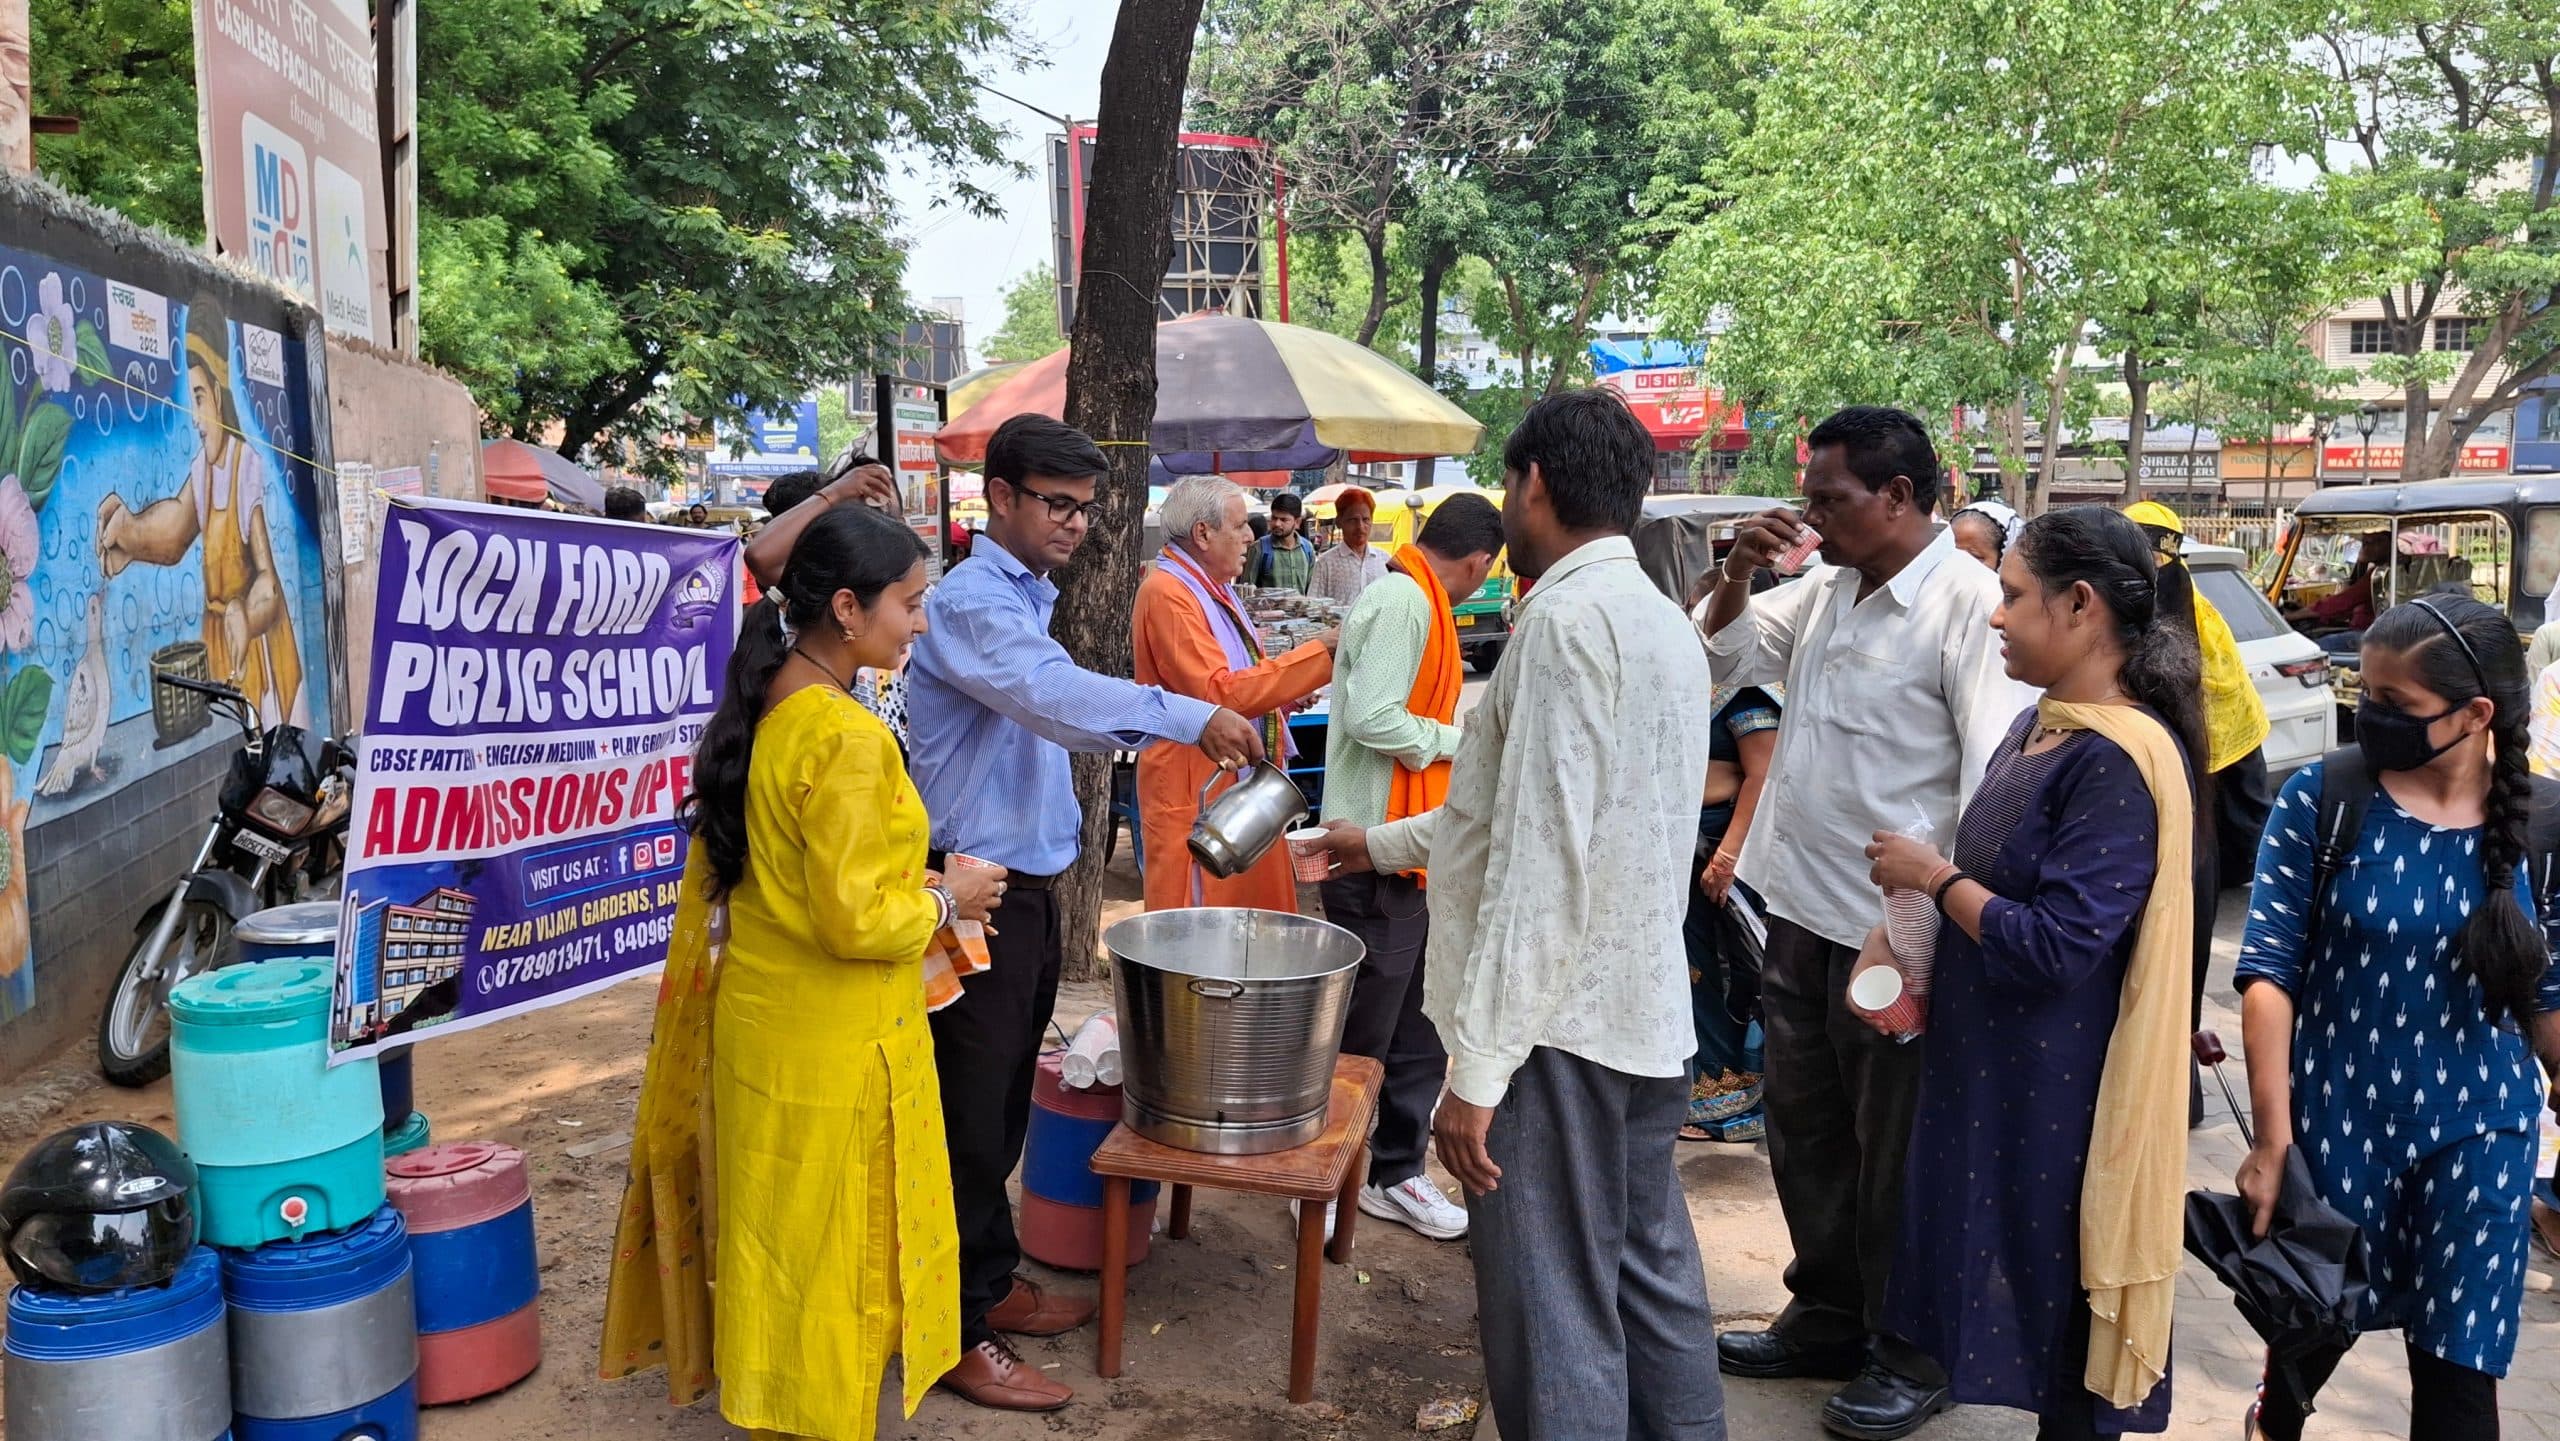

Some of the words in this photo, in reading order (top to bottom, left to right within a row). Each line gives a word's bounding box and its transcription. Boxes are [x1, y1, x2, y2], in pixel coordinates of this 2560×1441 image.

[214, 0, 280, 73] CASHLESS
[282, 44, 326, 107] FACILITY
[328, 83, 376, 144] AVAILABLE
[290, 94, 326, 145] through
[255, 143, 300, 231] MD
[325, 289, 346, 320] Medi
[139, 335, 159, 355] 2022
[2140, 455, 2178, 467] SHREE
[2180, 455, 2213, 467] AKA
[2152, 467, 2216, 477] JEWELERS
[2357, 458, 2404, 468] BHAWA
[2458, 458, 2498, 468] TURES
[546, 543, 672, 637] FORD
[378, 641, 553, 727] PUBLIC
[561, 641, 713, 721] SCHOOL
[370, 748, 418, 773] CBSE
[486, 743, 545, 768] ENGLISH
[545, 739, 597, 765] MEDIUM
[612, 735, 641, 757] PLAY
[362, 767, 629, 858] ADMISSIONS
[629, 755, 690, 819] OPE
[530, 865, 560, 892] VISIT
[563, 860, 581, 883] US
[584, 855, 601, 879] AT
[480, 920, 533, 952] NEAR
[535, 905, 578, 942] VIJAYA
[581, 887, 654, 928] GARDENS,
[495, 932, 610, 989] 8789813471,
[613, 913, 676, 955] 840969
